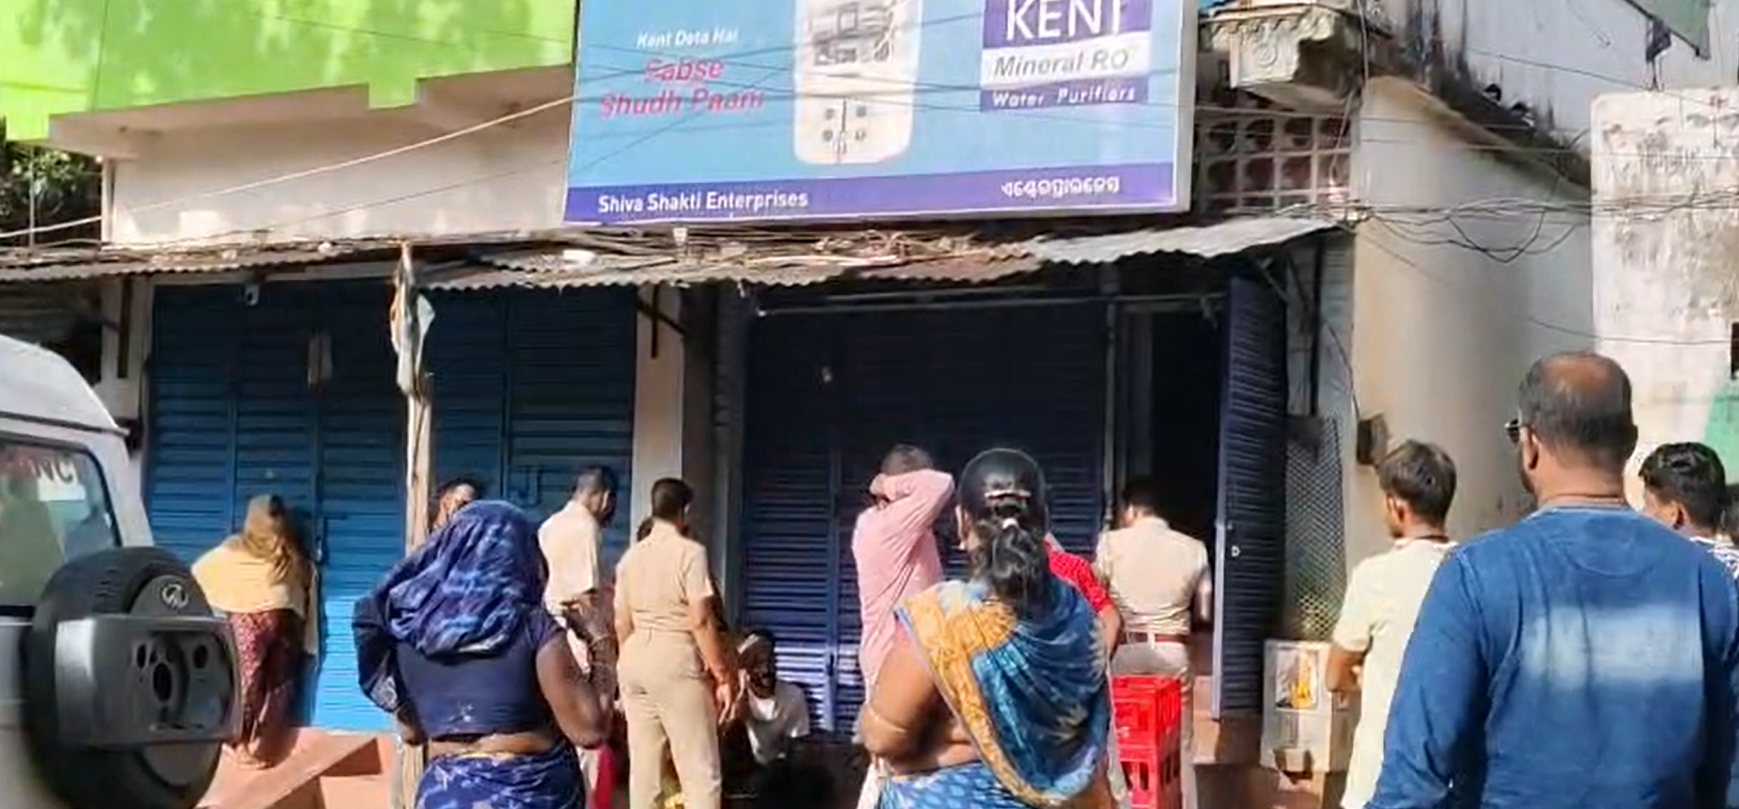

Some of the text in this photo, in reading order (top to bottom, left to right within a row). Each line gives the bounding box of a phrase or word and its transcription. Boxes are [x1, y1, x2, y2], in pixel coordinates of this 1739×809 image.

[637, 32, 671, 48] Kent
[645, 57, 723, 82] Sabse
[994, 49, 1129, 77] Mineral RO
[599, 87, 764, 118] Shudh Paani
[992, 86, 1136, 107] Water Purifiers
[598, 190, 809, 213] Shiva Shakti Enterprises
